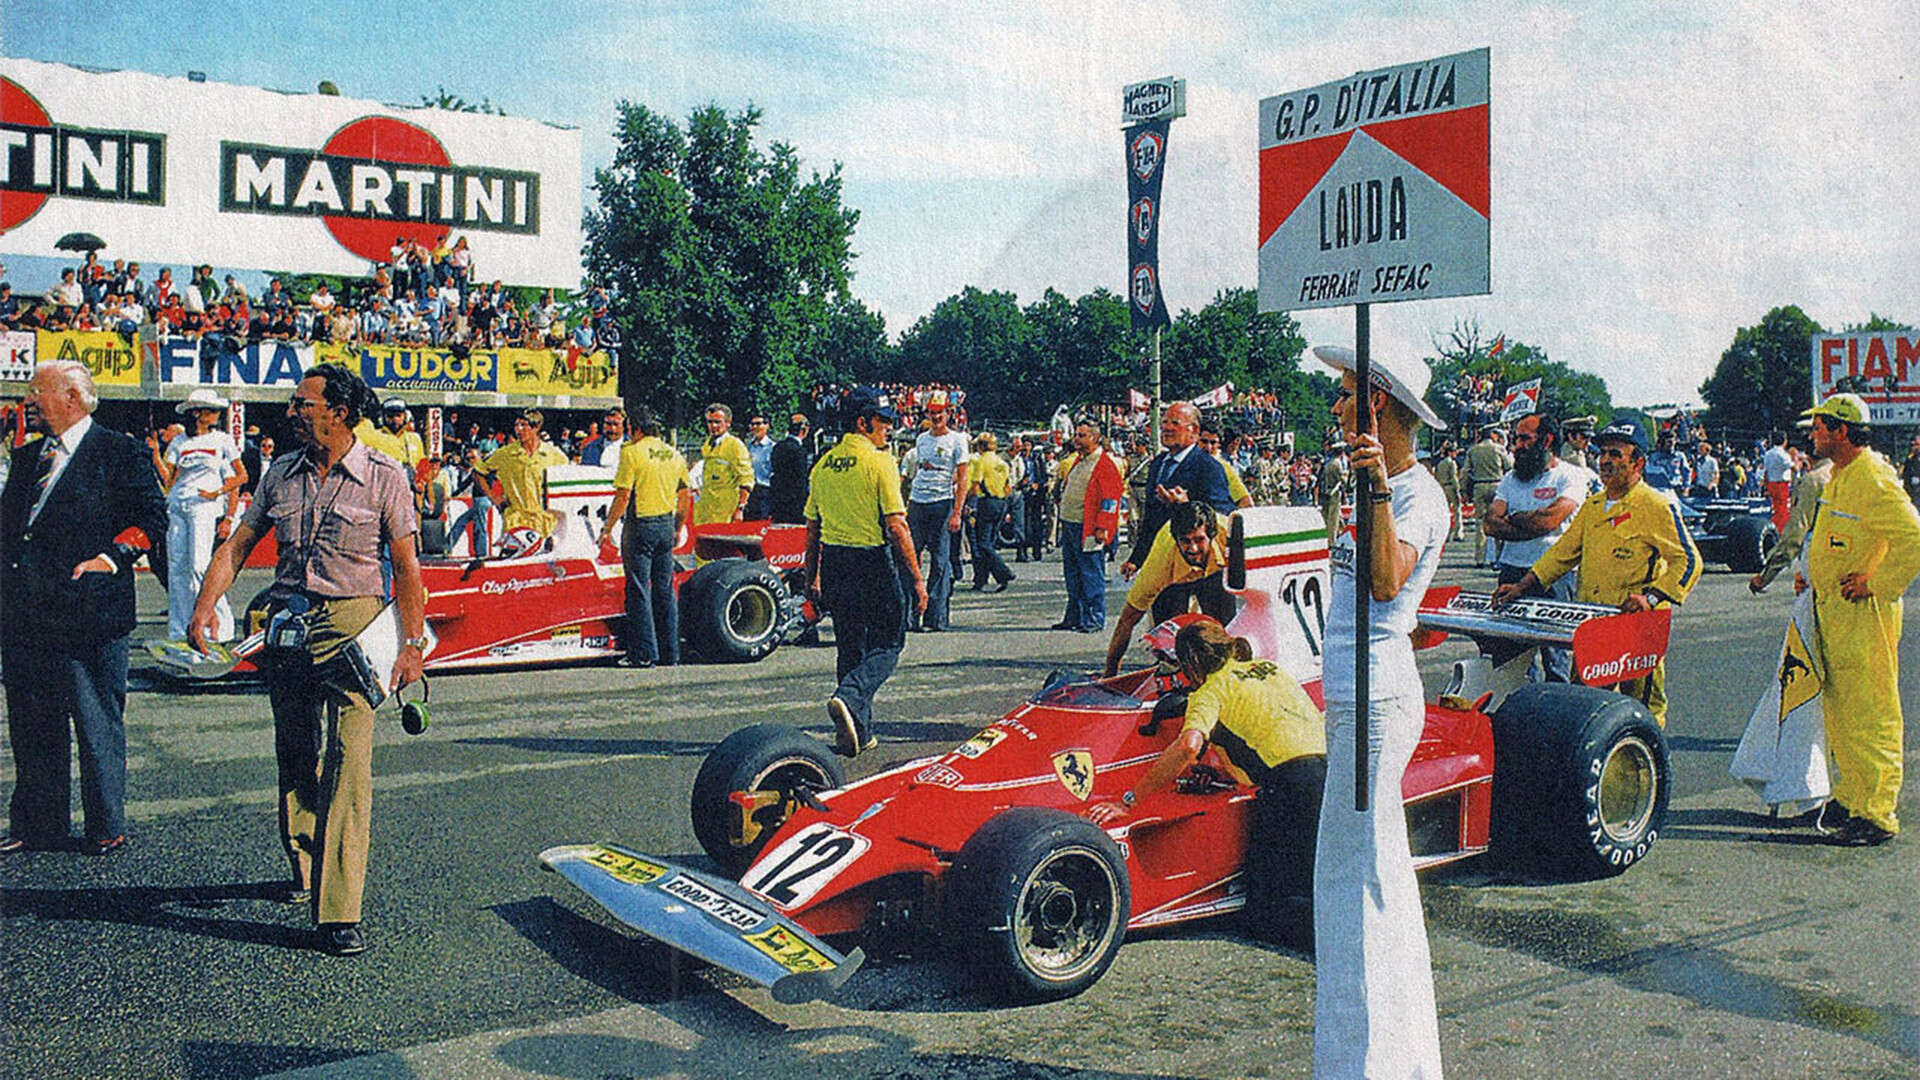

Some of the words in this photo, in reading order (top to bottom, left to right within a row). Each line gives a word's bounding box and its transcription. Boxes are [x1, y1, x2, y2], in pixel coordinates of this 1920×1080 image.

[1276, 93, 1320, 140] G.P.
[1333, 62, 1456, 129] D'ITALIA
[235, 153, 527, 226] MARTINI
[1319, 176, 1407, 251] LAUDA
[1370, 262, 1433, 295] SEFAC
[57, 338, 136, 377] Agip
[160, 338, 305, 386] FINA
[368, 348, 493, 381] TUDOR
[821, 453, 858, 472] Agip
[752, 829, 855, 905] 12
